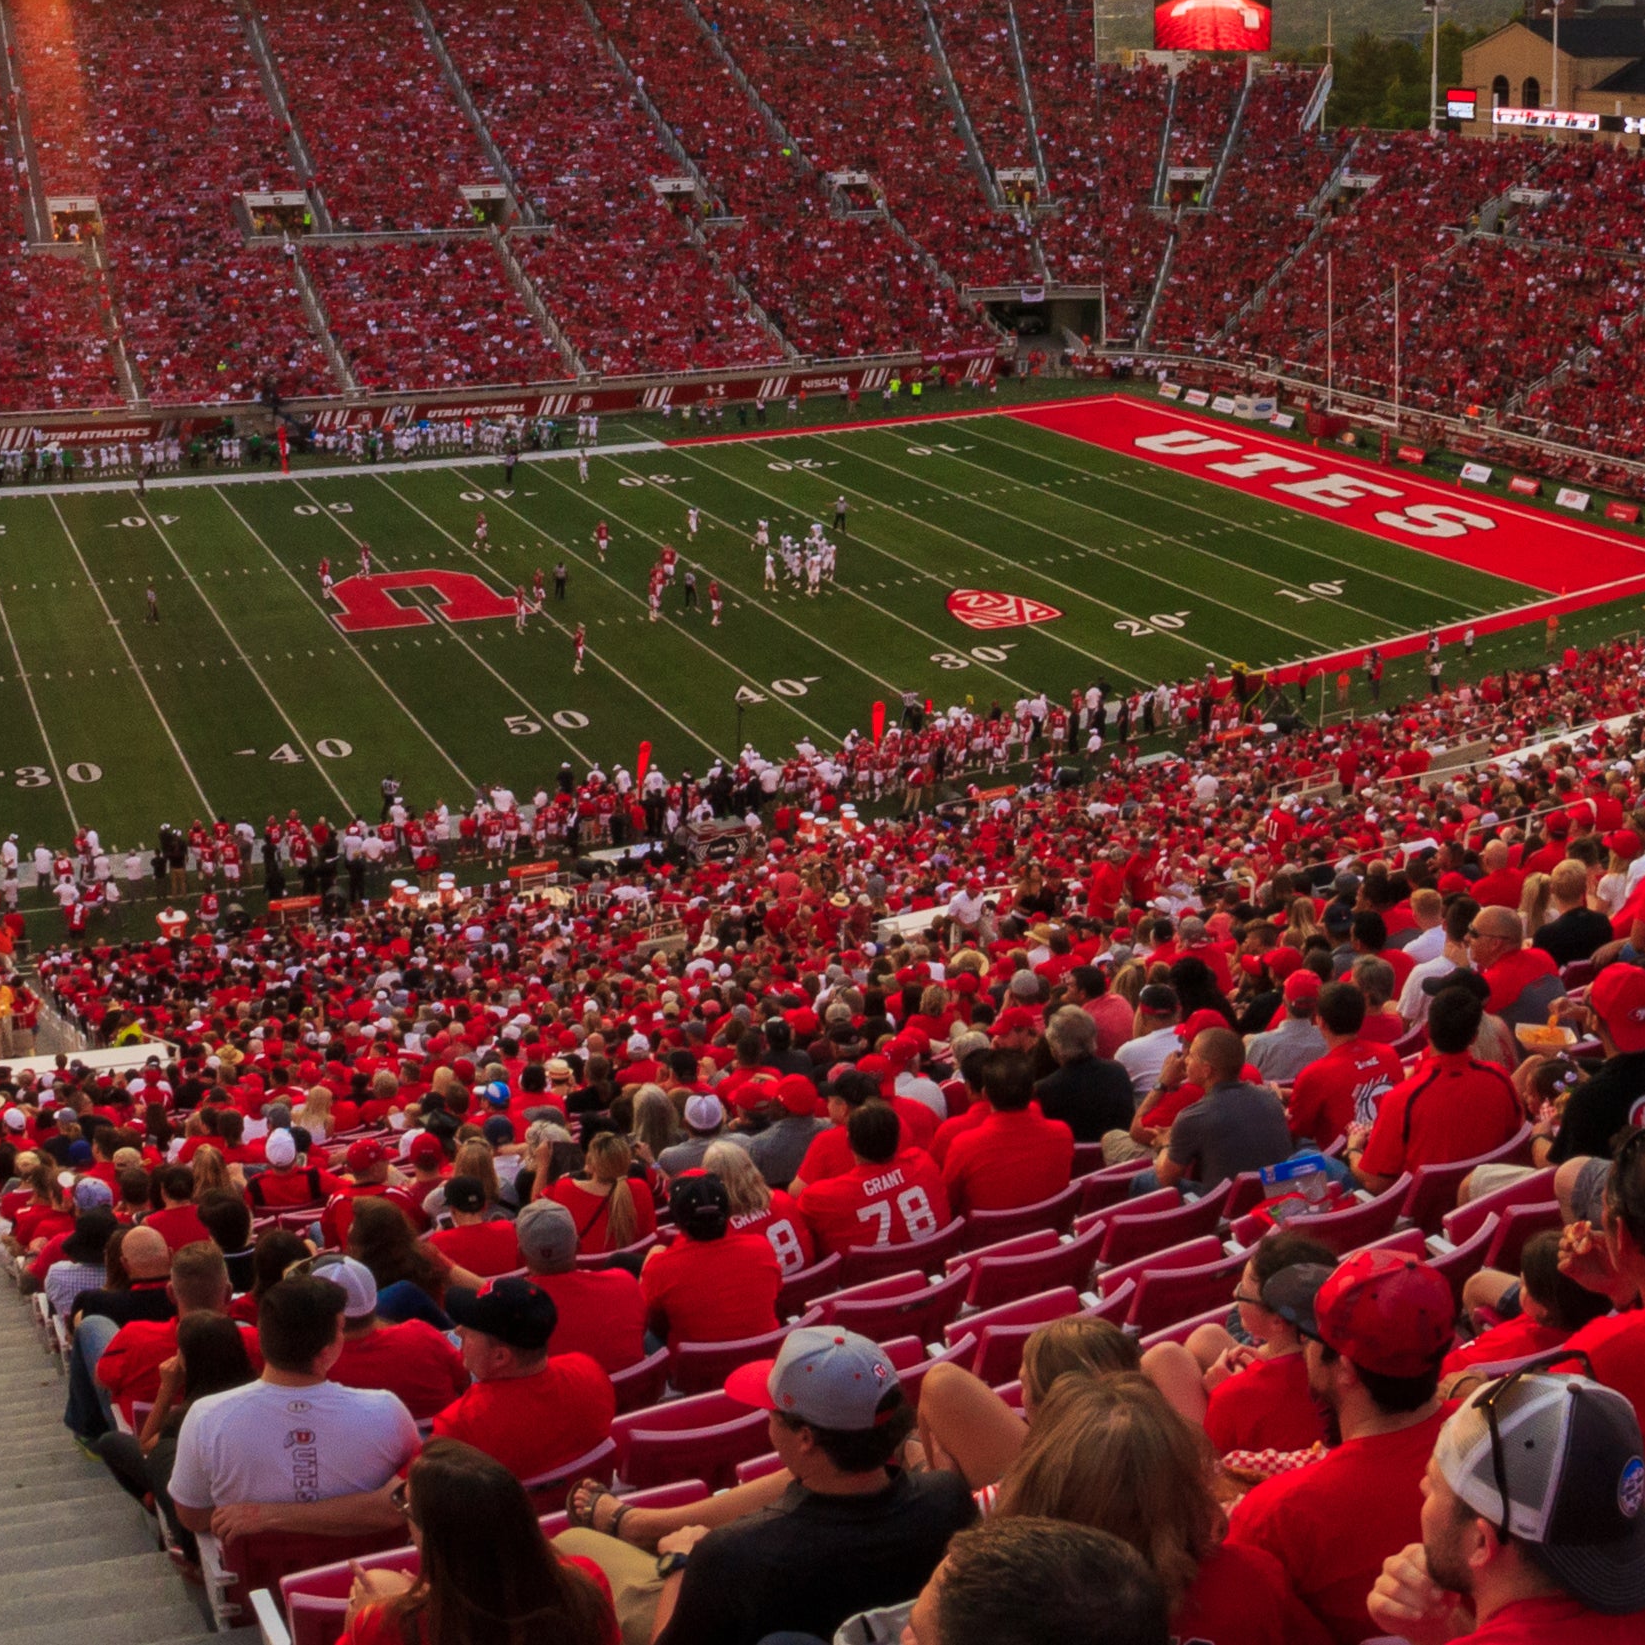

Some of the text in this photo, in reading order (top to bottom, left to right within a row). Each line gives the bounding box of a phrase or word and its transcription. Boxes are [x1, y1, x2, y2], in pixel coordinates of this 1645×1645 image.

[801, 377, 849, 389] NISSAN
[427, 404, 525, 419] UTAH FOOTBALL
[78, 427, 150, 440] ATHLETICS
[1134, 429, 1496, 538] UTES
[330, 569, 537, 632] U
[1274, 582, 1344, 603] 10
[1114, 613, 1186, 637] 20
[930, 646, 1008, 670] 30
[735, 679, 808, 704] 40
[503, 710, 590, 735] 50
[268, 738, 353, 764] 40
[15, 762, 103, 788] 30
[862, 1167, 906, 1197] GRANT
[855, 1184, 937, 1251] 78
[292, 1447, 318, 1503] UTES
